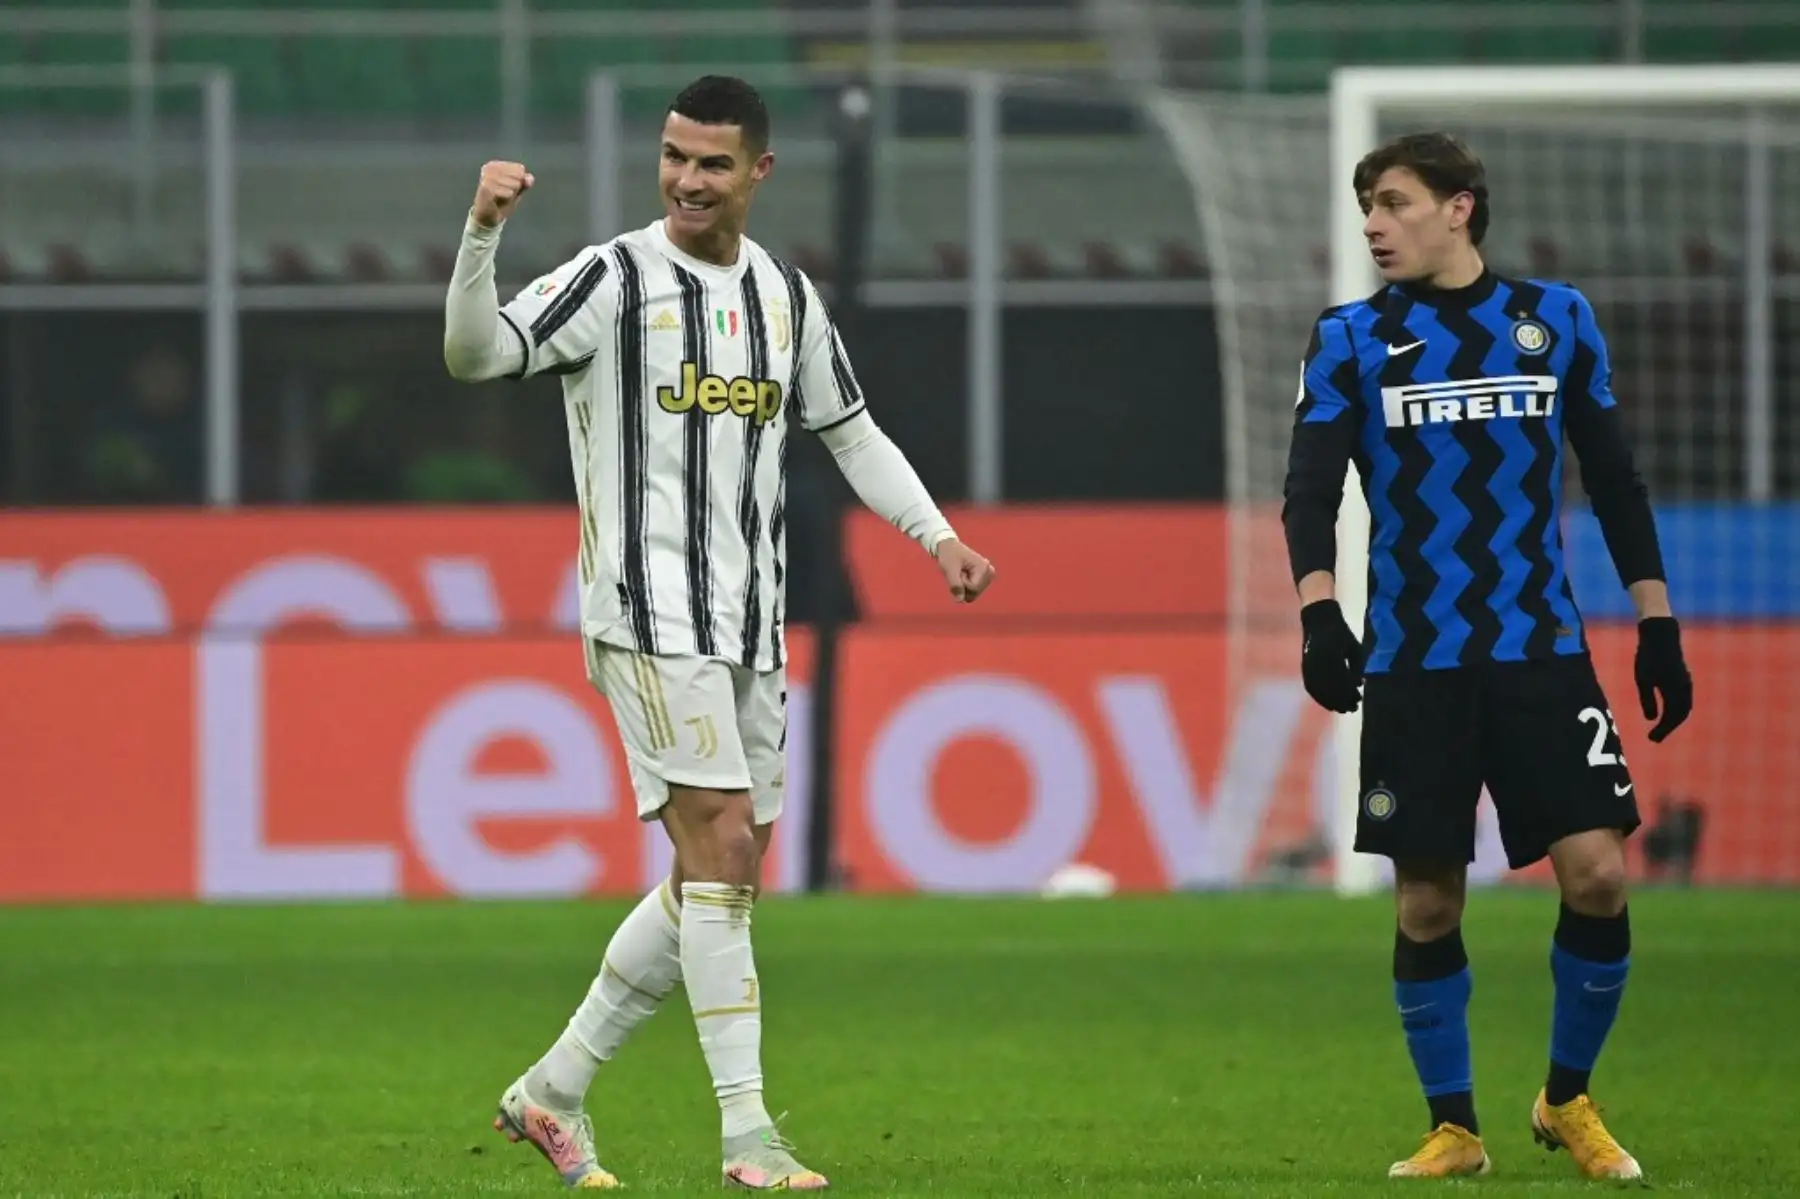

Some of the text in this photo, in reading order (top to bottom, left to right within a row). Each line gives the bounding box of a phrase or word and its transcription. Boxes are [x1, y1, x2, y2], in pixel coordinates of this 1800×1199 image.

[656, 361, 783, 428] Jeep
[1380, 375, 1559, 428] PIRELLI
[197, 635, 1510, 897] Leov
[1577, 706, 1627, 767] 2
